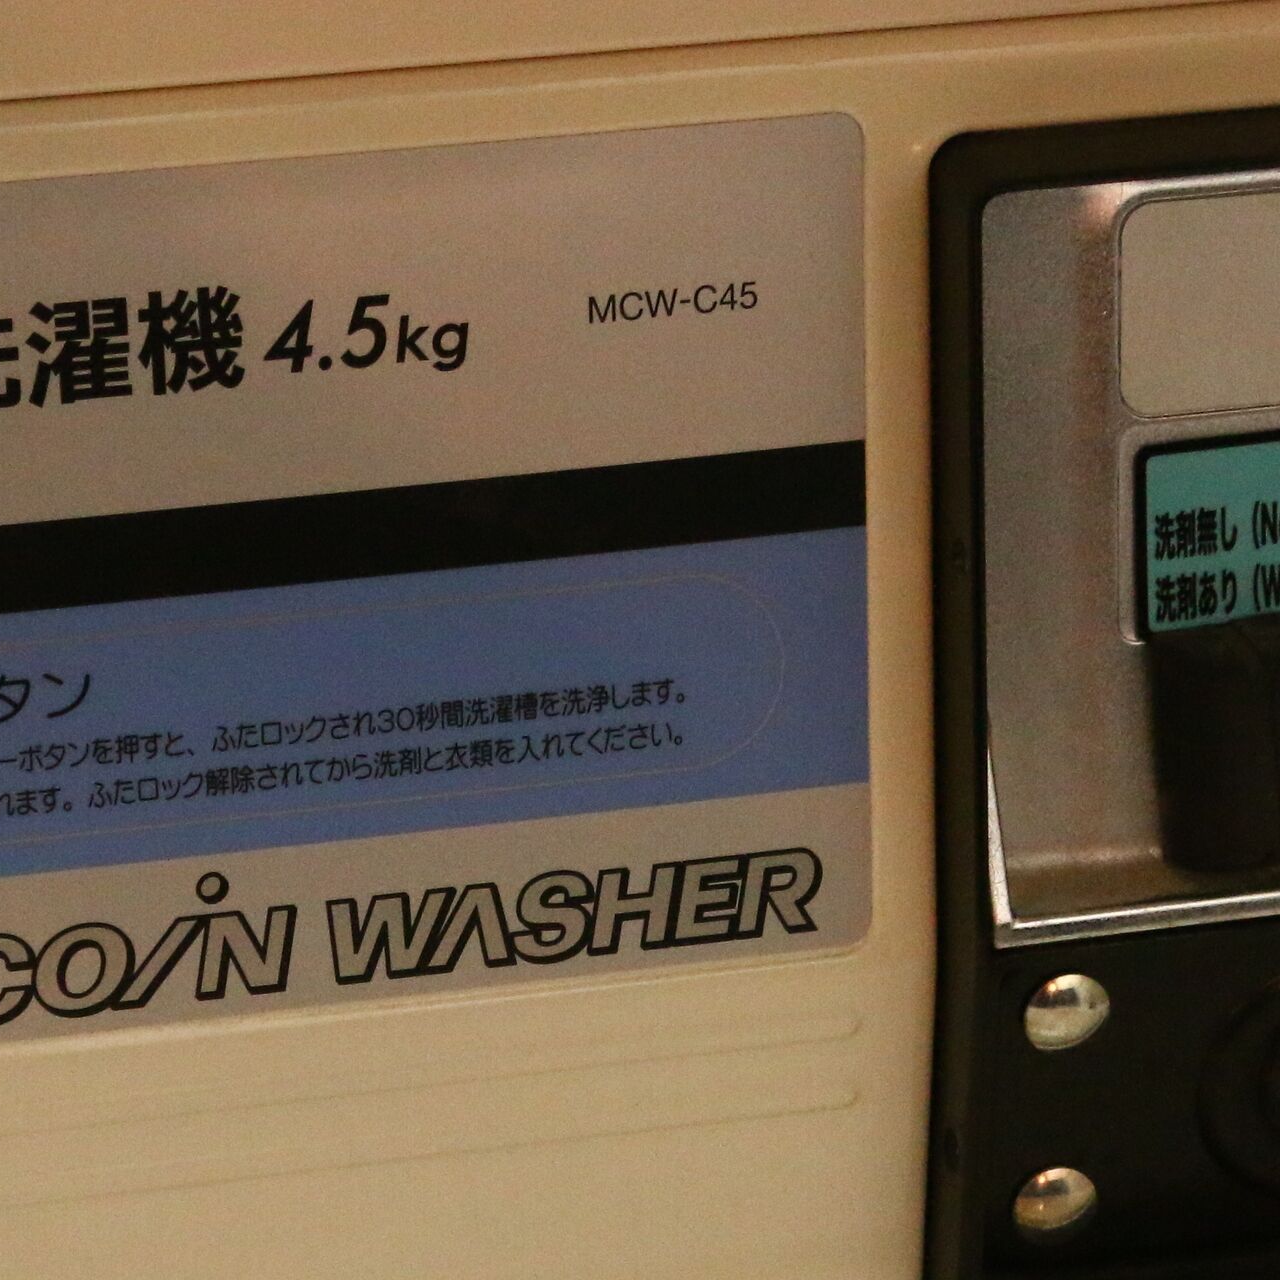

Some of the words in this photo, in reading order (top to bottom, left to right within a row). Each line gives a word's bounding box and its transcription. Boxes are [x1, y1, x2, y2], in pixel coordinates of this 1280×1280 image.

[588, 280, 759, 325] MCW-C45
[263, 293, 470, 373] 4.5kg
[1153, 505, 1238, 562] 洗剤無し
[1154, 567, 1238, 623] 洗剤あり
[326, 847, 822, 985] WASHER
